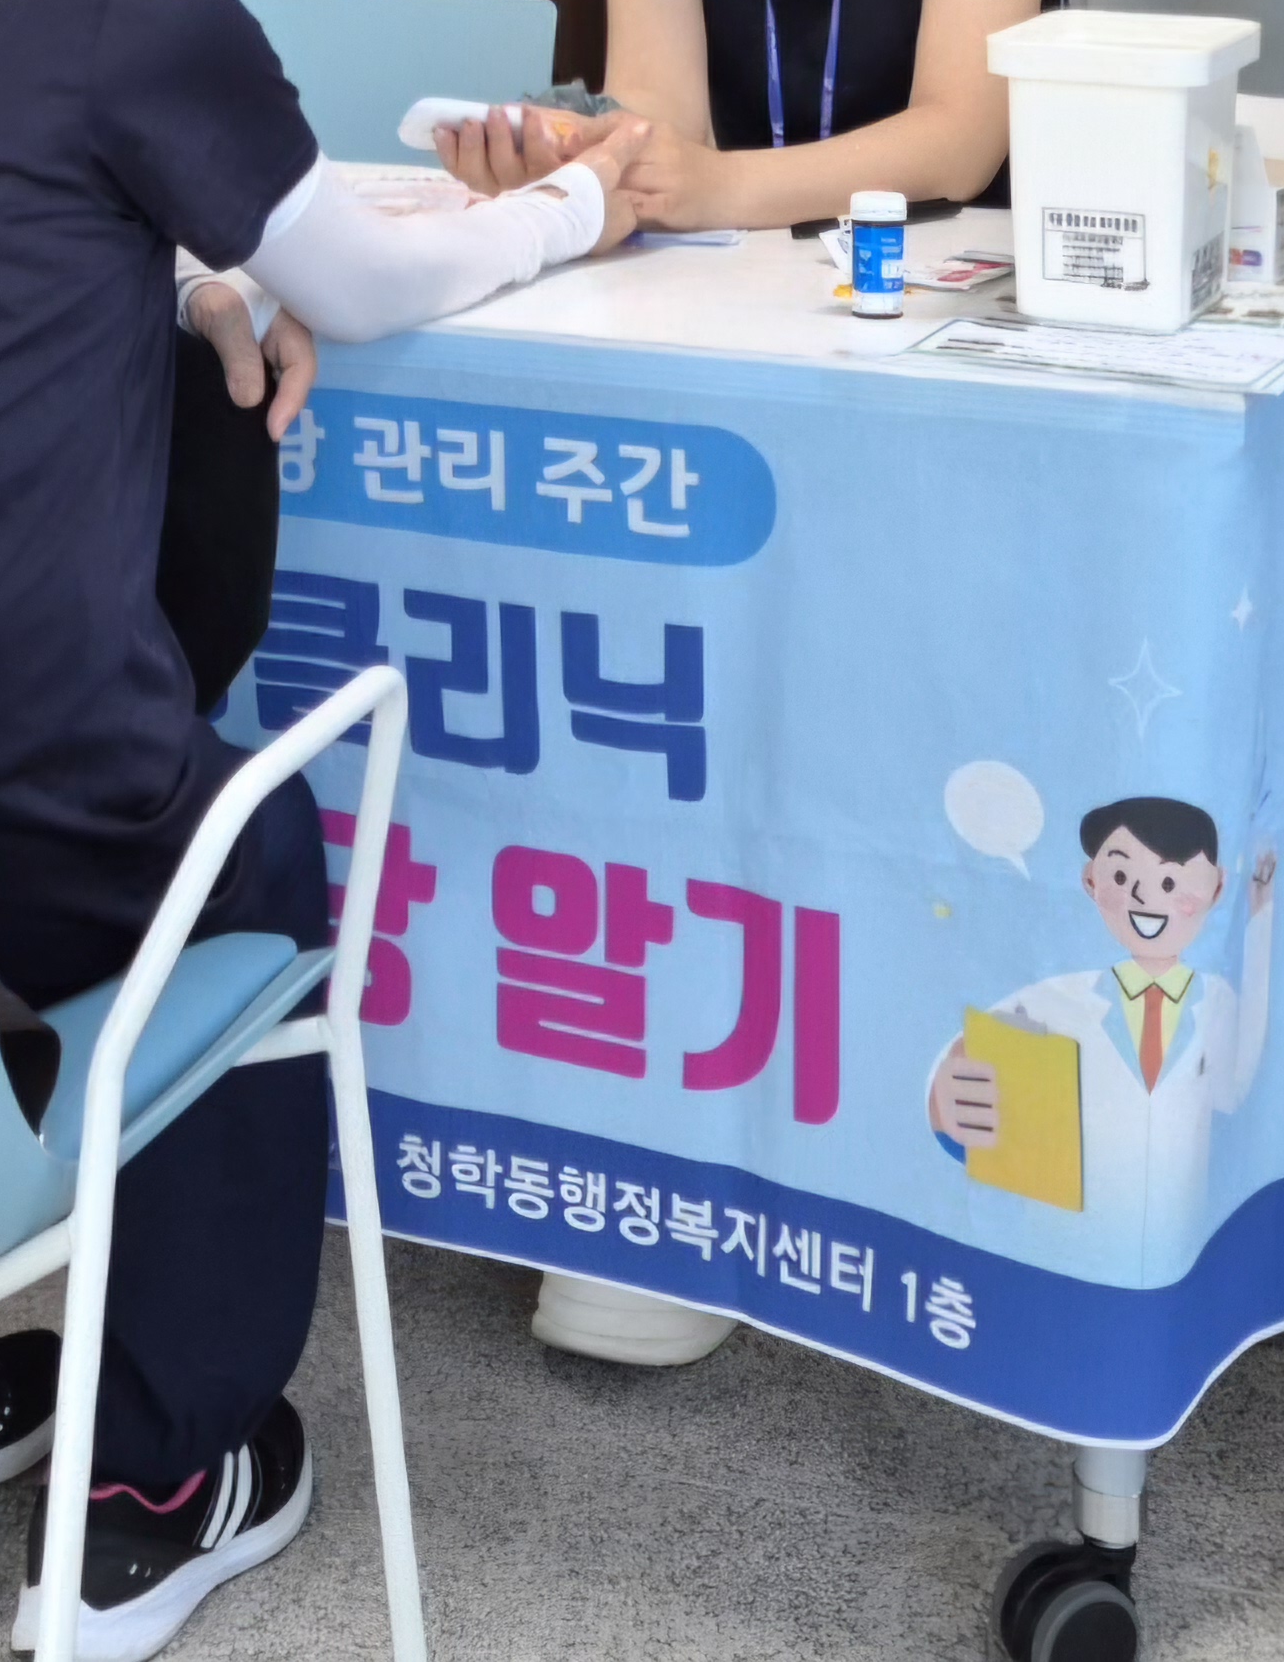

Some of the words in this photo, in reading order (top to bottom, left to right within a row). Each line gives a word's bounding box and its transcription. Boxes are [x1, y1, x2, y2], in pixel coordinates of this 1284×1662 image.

[353, 415, 506, 512] 관리
[535, 436, 701, 538] 주간
[216, 567, 708, 802] 클리닉
[491, 844, 841, 1126] 알기
[395, 1132, 876, 1313] 청학동행정복지센터
[899, 1270, 978, 1351] 1층
